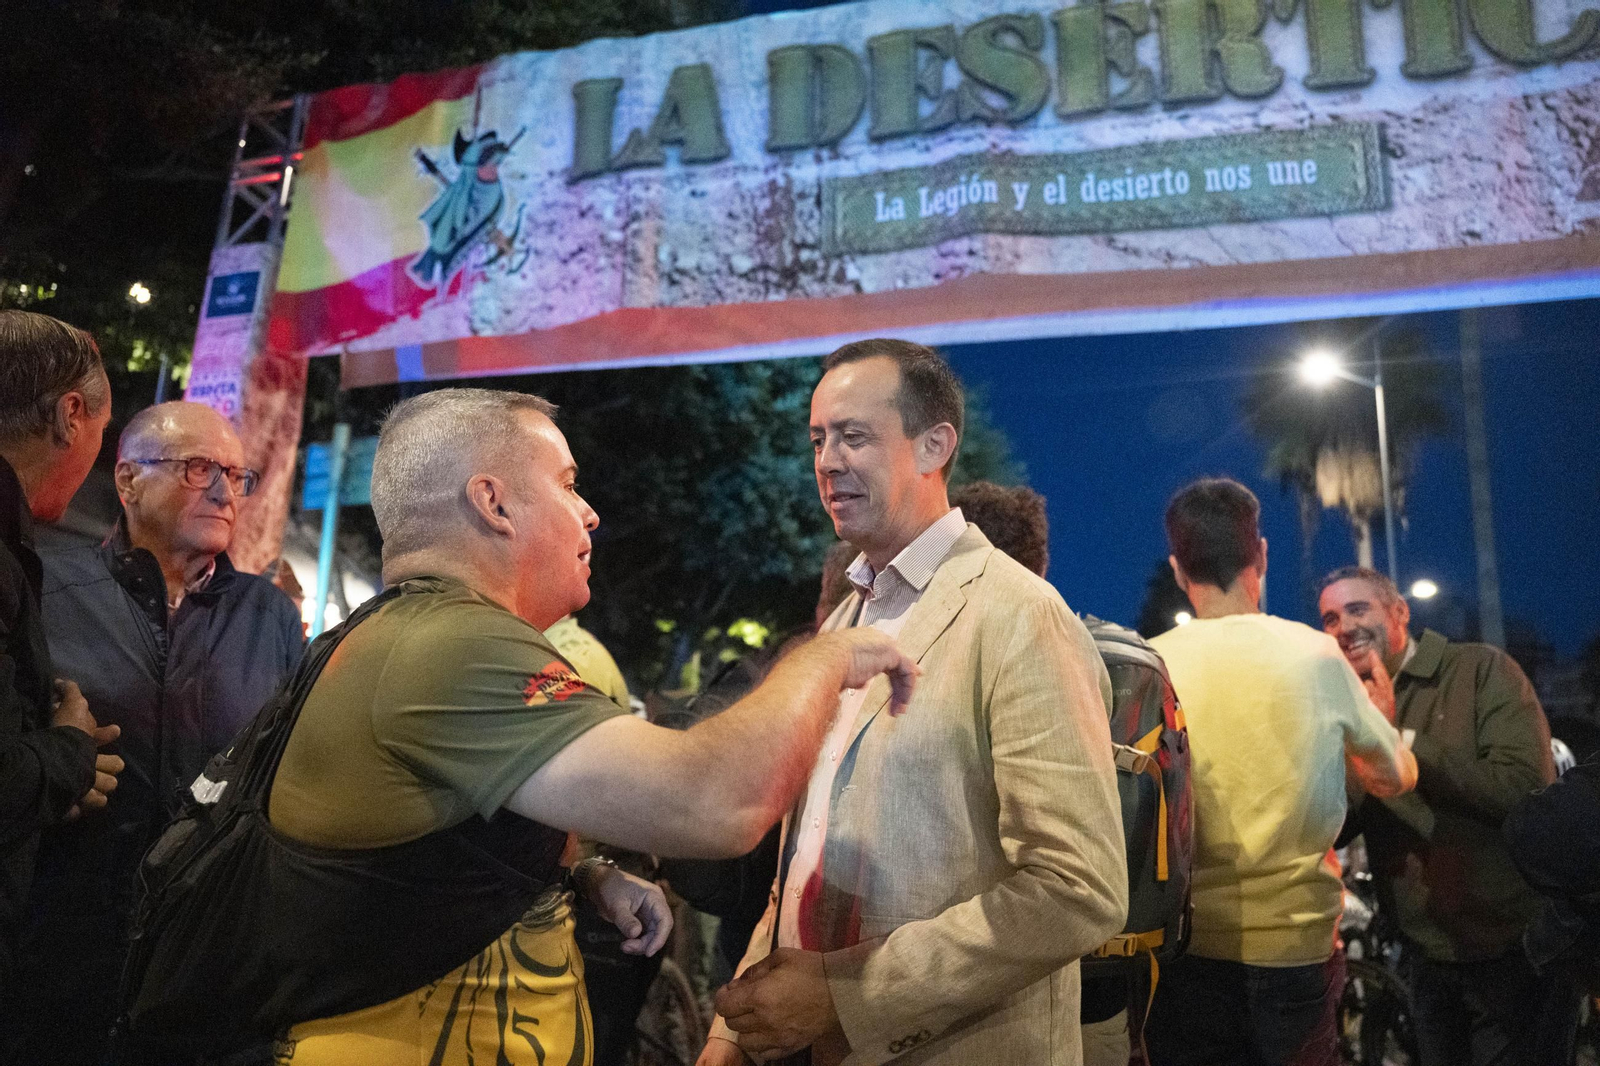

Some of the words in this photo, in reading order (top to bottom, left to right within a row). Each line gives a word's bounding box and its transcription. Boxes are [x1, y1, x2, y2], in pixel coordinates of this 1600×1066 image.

[569, 62, 732, 184] LA
[874, 191, 906, 223] La
[918, 173, 998, 218] Legión
[1012, 182, 1031, 210] y
[1043, 174, 1067, 206] el
[1080, 168, 1190, 202] desierto
[1205, 165, 1253, 192] nos
[1267, 159, 1319, 186] une
